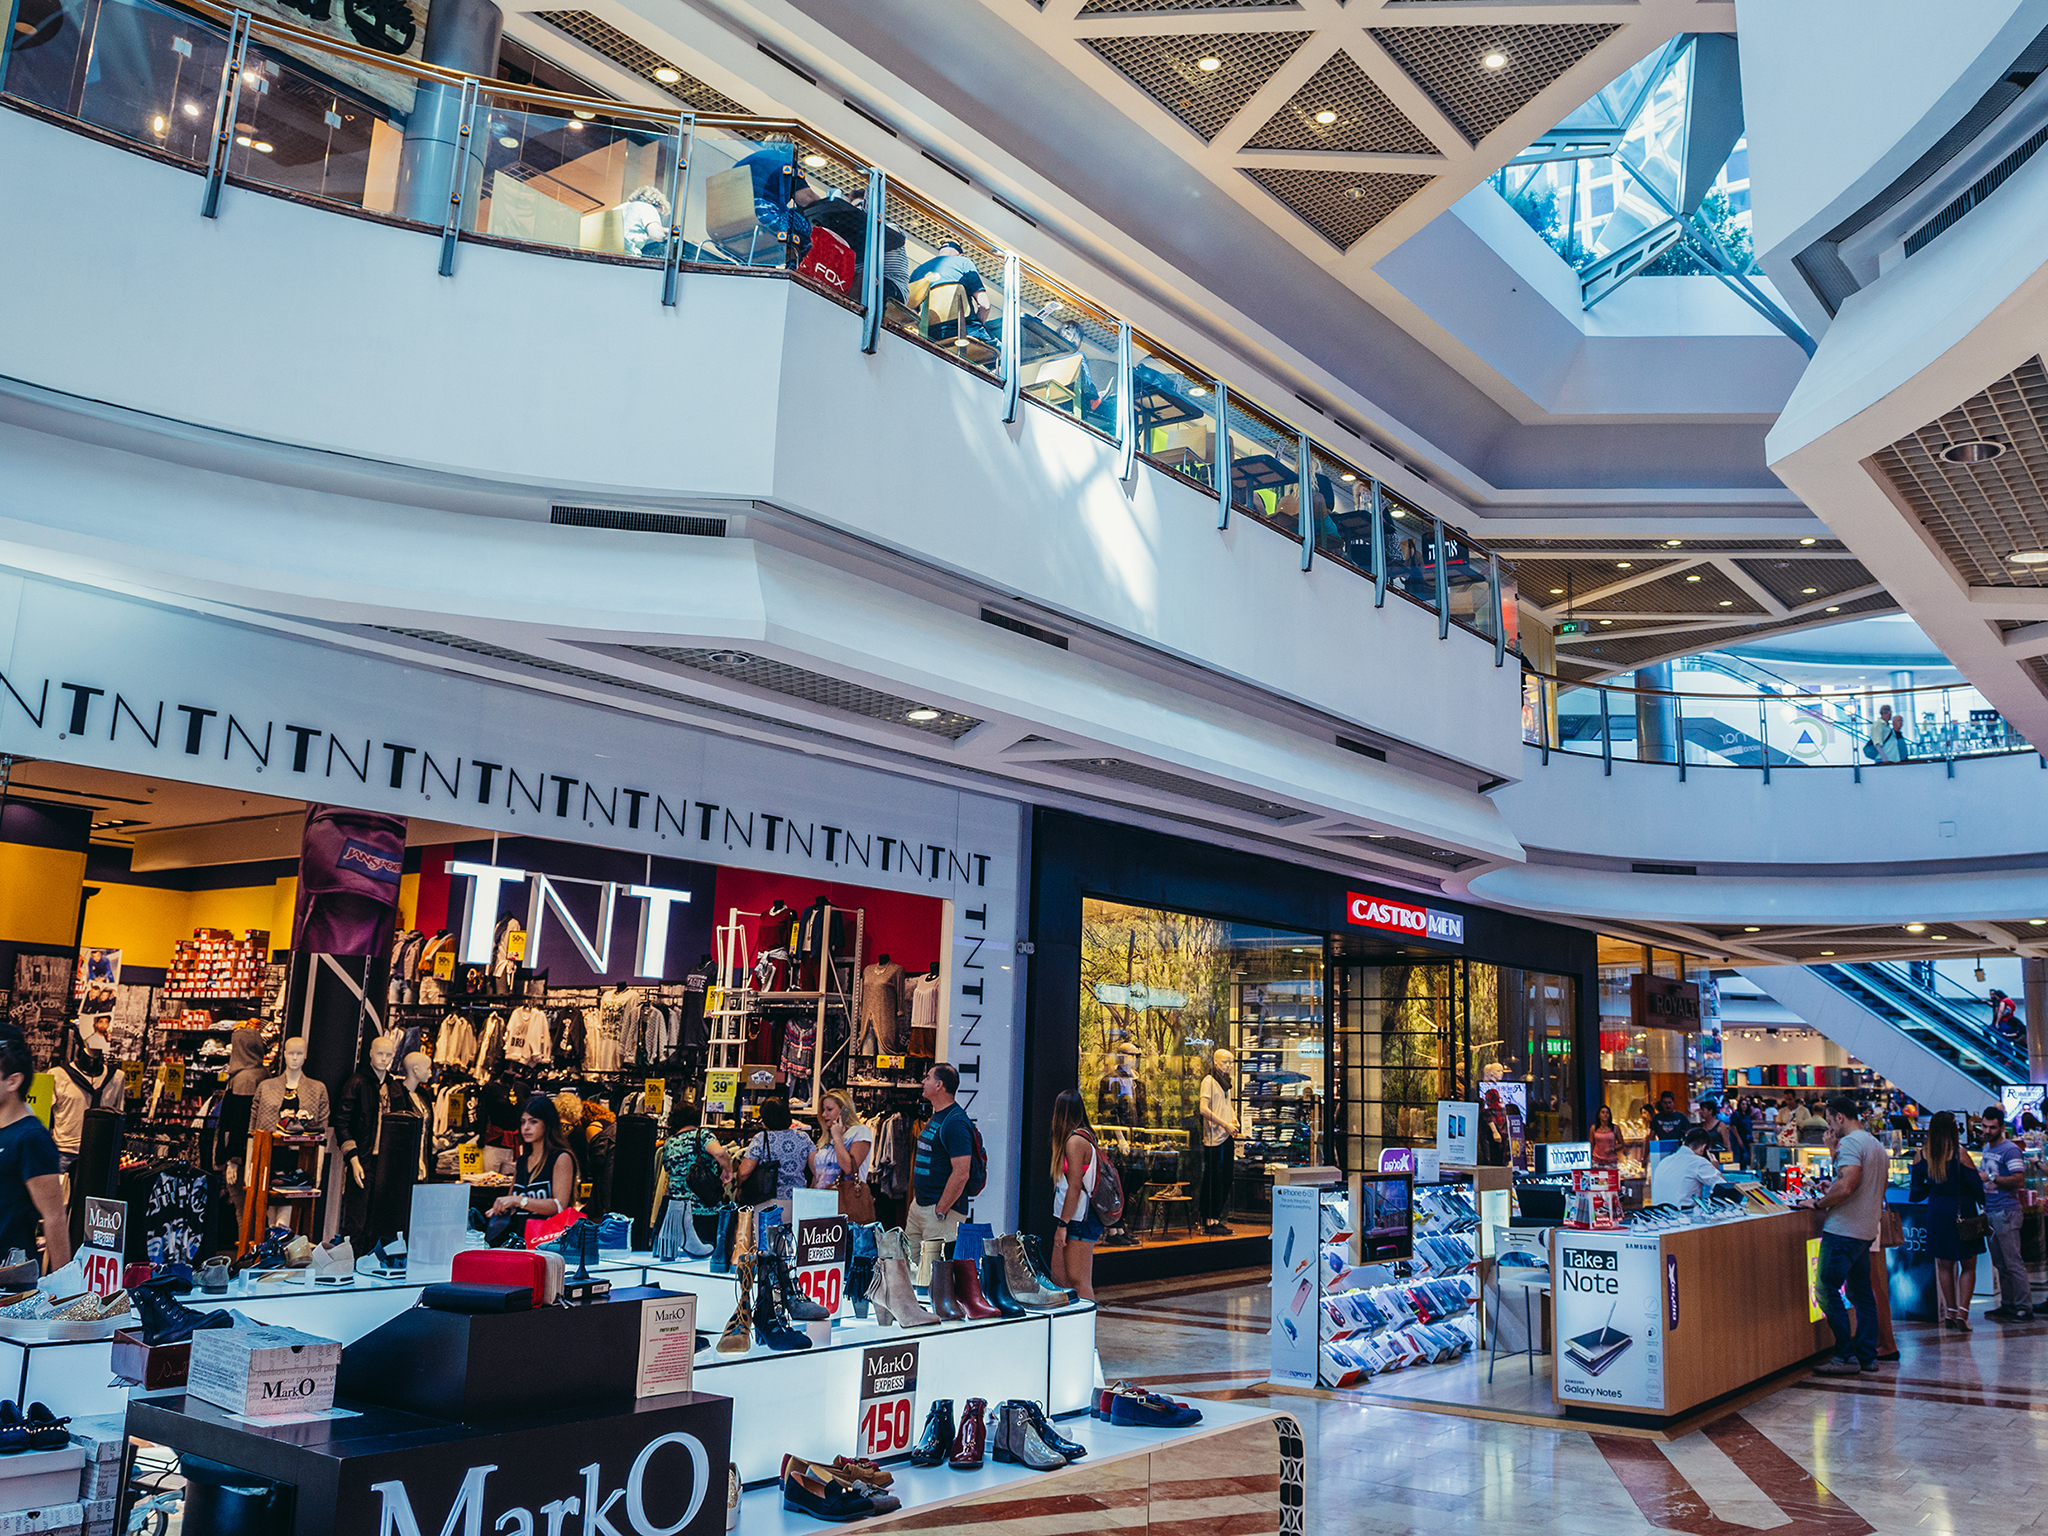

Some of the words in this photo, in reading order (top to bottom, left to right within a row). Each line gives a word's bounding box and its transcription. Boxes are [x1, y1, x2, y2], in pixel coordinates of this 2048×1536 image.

[815, 262, 845, 292] FOX
[343, 847, 402, 872] JANSPOR
[444, 861, 692, 978] TNT
[1352, 899, 1426, 931] CASTRO
[1428, 914, 1461, 938] MEN
[9, 1000, 39, 1018] ROCK
[1657, 994, 1700, 1019] ROYALT
[125, 1070, 137, 1081] 39
[647, 1084, 661, 1093] 50%
[712, 1081, 728, 1093] 39
[463, 1153, 475, 1164] 59
[1283, 1189, 1301, 1197] iPhone
[88, 1207, 122, 1230] MarkO
[93, 1230, 116, 1247] EXPRESS
[802, 1225, 843, 1246] MarkO
[808, 1246, 835, 1262] EXPRESS
[1565, 1249, 1603, 1269] Take
[1606, 1257, 1616, 1270] a
[83, 1254, 118, 1297] 150
[1563, 1270, 1619, 1295] Note
[655, 1308, 686, 1322] MarkO
[867, 1352, 914, 1376] MarkO
[261, 1378, 315, 1400] MarkO
[874, 1375, 905, 1393] EXPRESS
[1564, 1385, 1595, 1397] Galaxy
[1596, 1389, 1623, 1398] Note5
[861, 1398, 911, 1454] 150
[371, 1432, 709, 1536] MarkO
